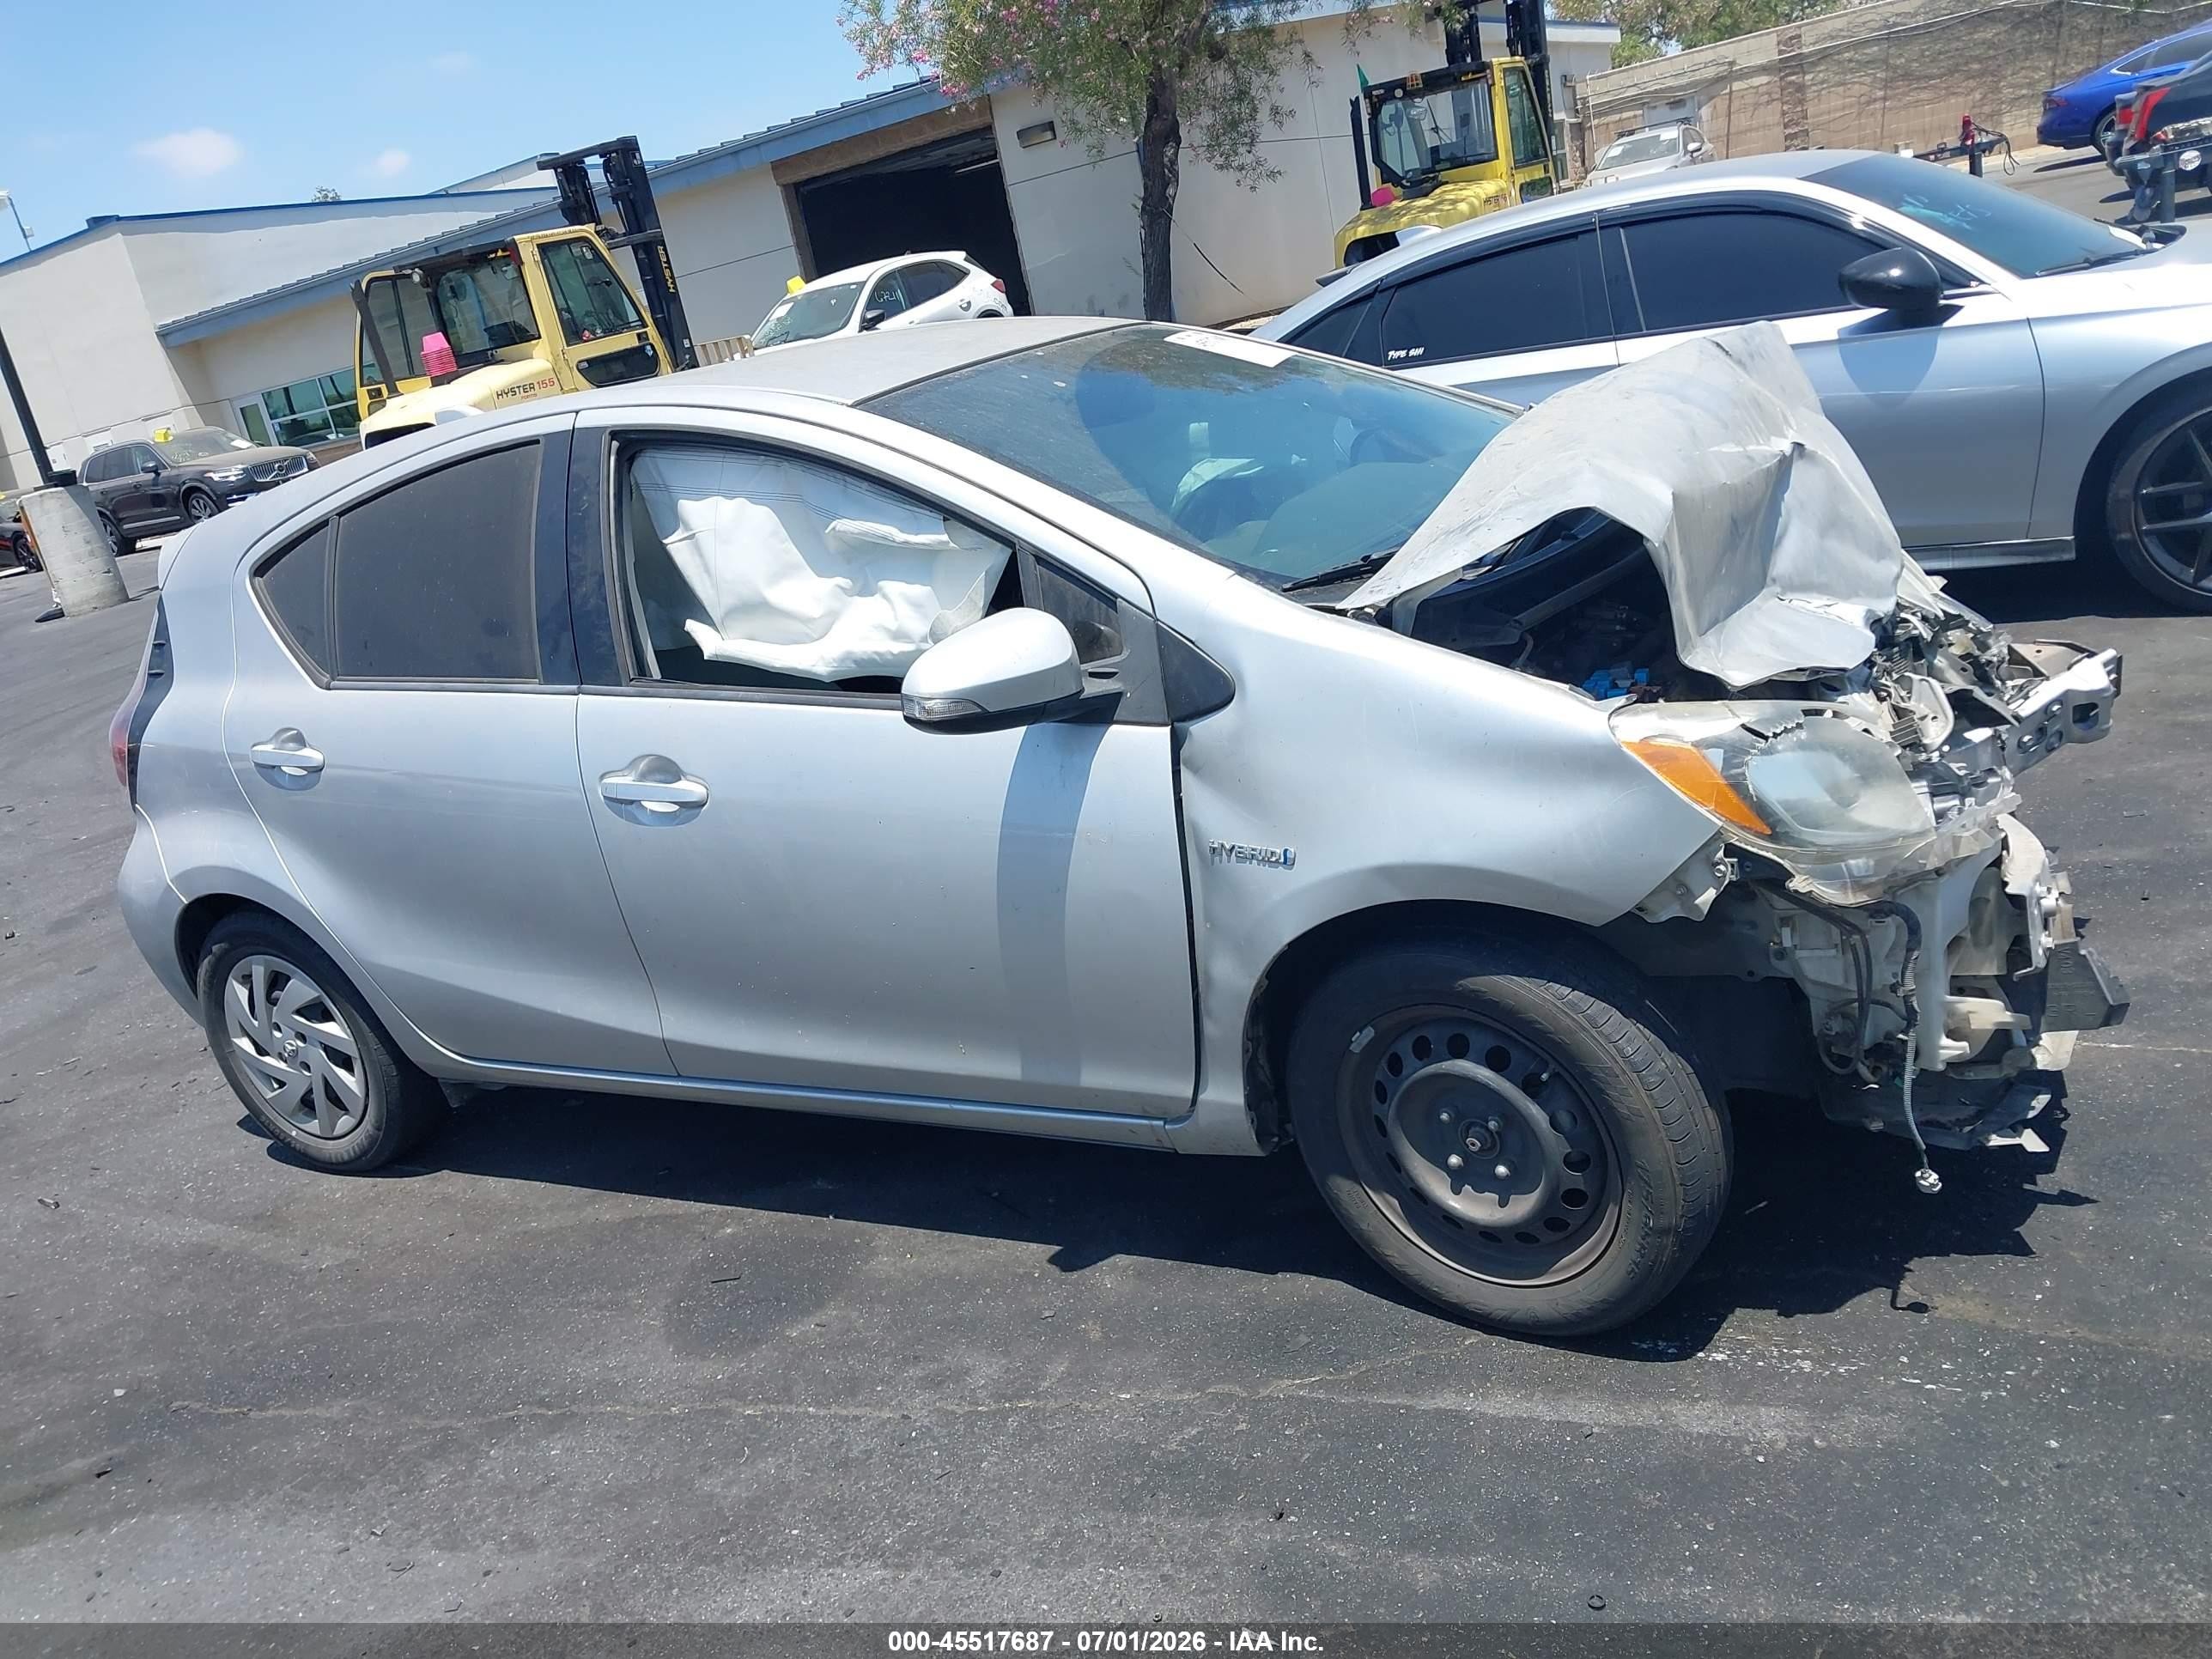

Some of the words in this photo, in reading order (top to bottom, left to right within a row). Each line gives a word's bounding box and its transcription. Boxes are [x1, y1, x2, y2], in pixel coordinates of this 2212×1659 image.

[657, 246, 676, 293] HYSTER
[1388, 349, 1408, 361] TYPE
[495, 382, 536, 400] HYSTER
[536, 377, 556, 390] 155
[1208, 839, 1282, 864] HYBRID
